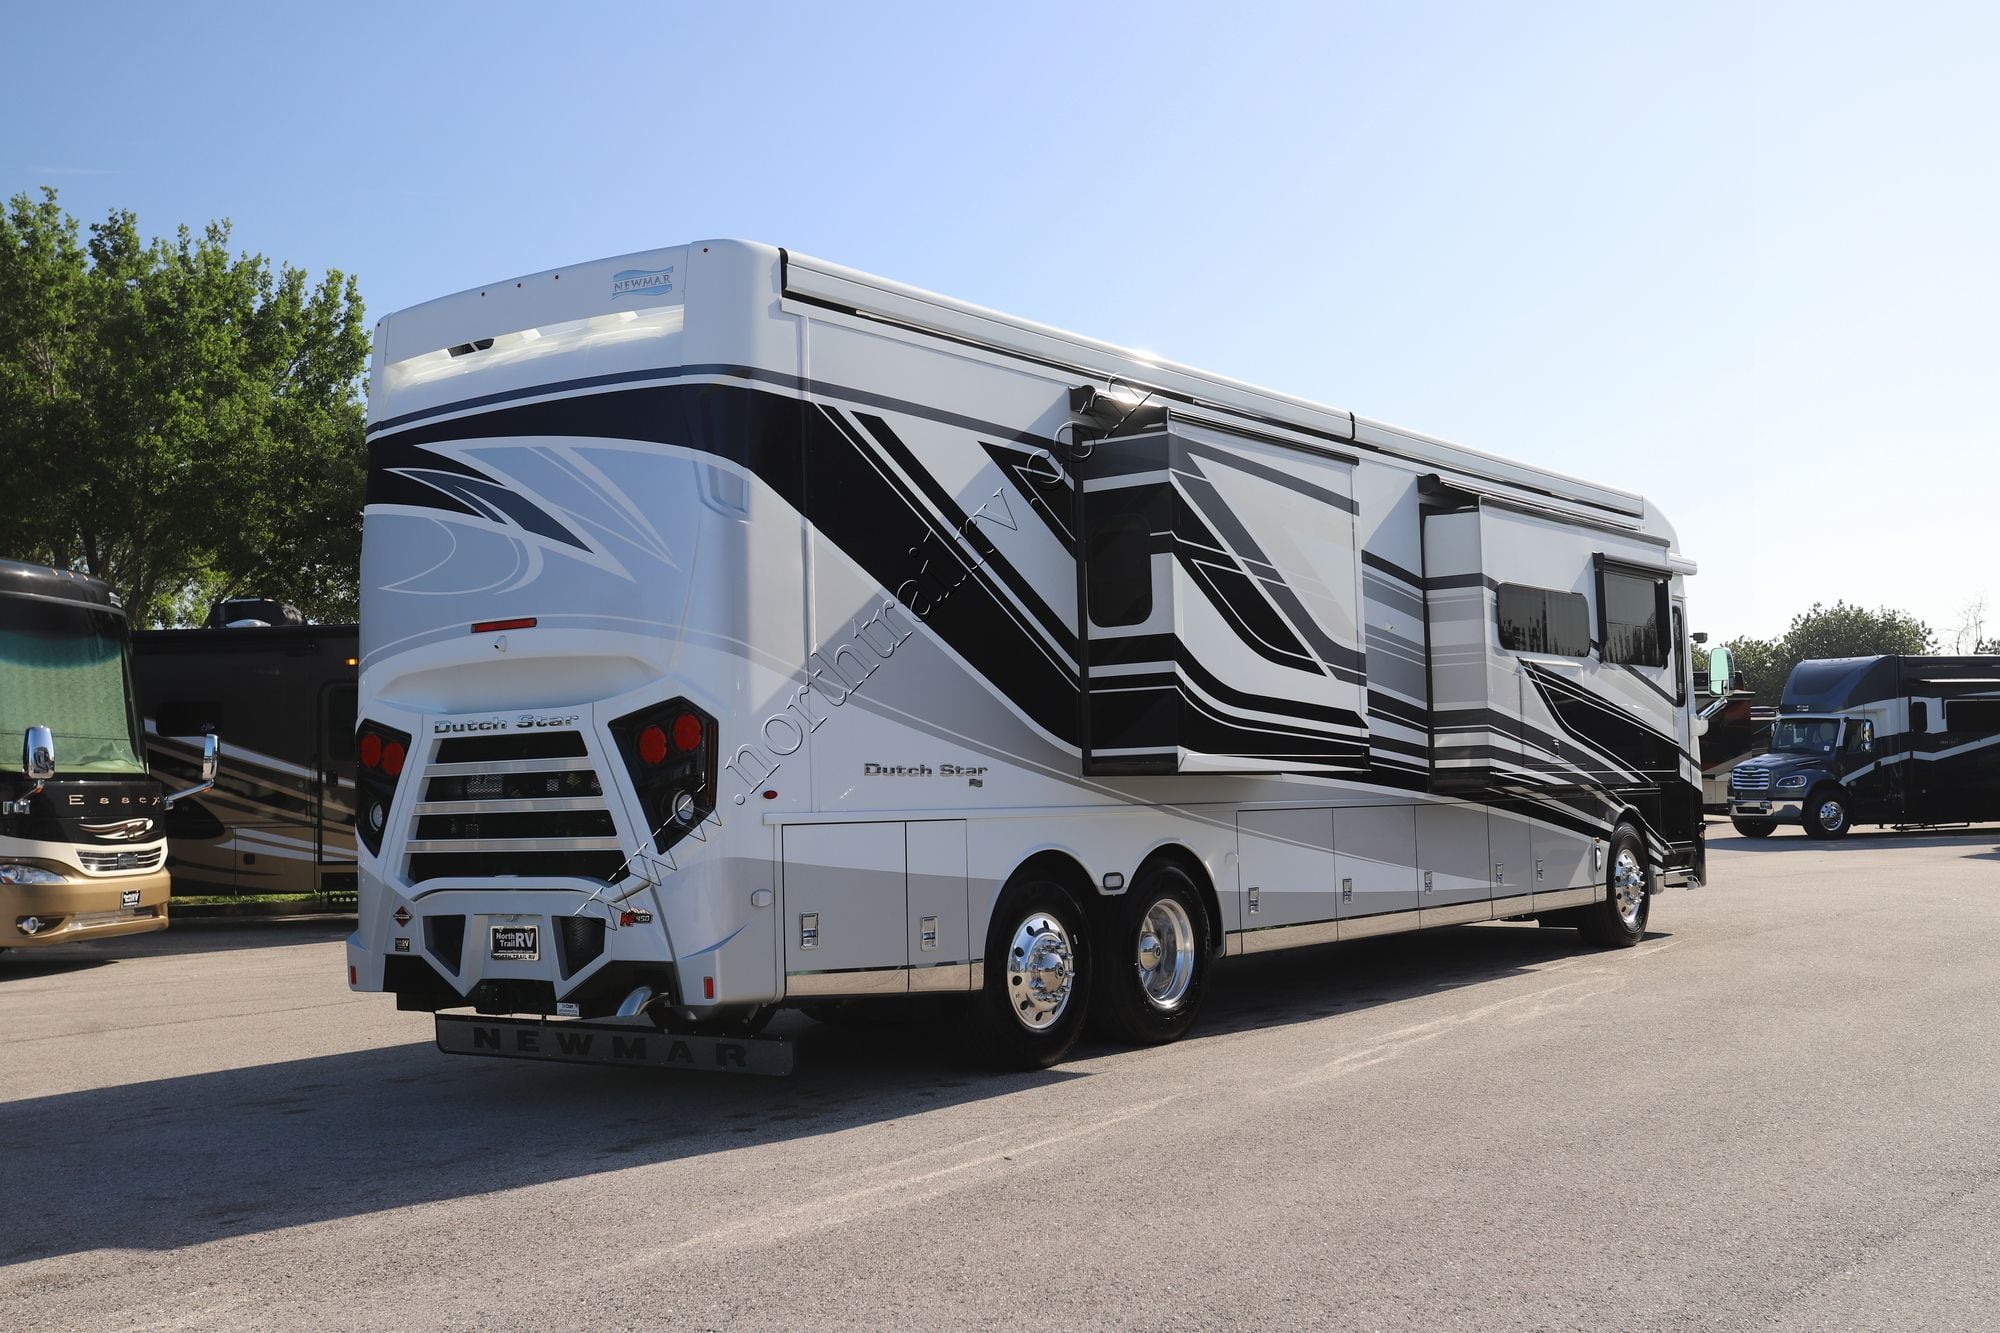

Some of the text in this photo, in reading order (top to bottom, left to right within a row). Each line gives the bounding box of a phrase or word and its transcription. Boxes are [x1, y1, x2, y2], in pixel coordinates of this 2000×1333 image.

[614, 274, 672, 292] NEWMAR
[434, 713, 580, 734] Dutch Star
[863, 762, 989, 777] Dutch Star
[496, 932, 515, 940] North
[499, 939, 515, 948] Trail
[515, 932, 535, 948] RV
[473, 1026, 747, 1067] NEWMAR
